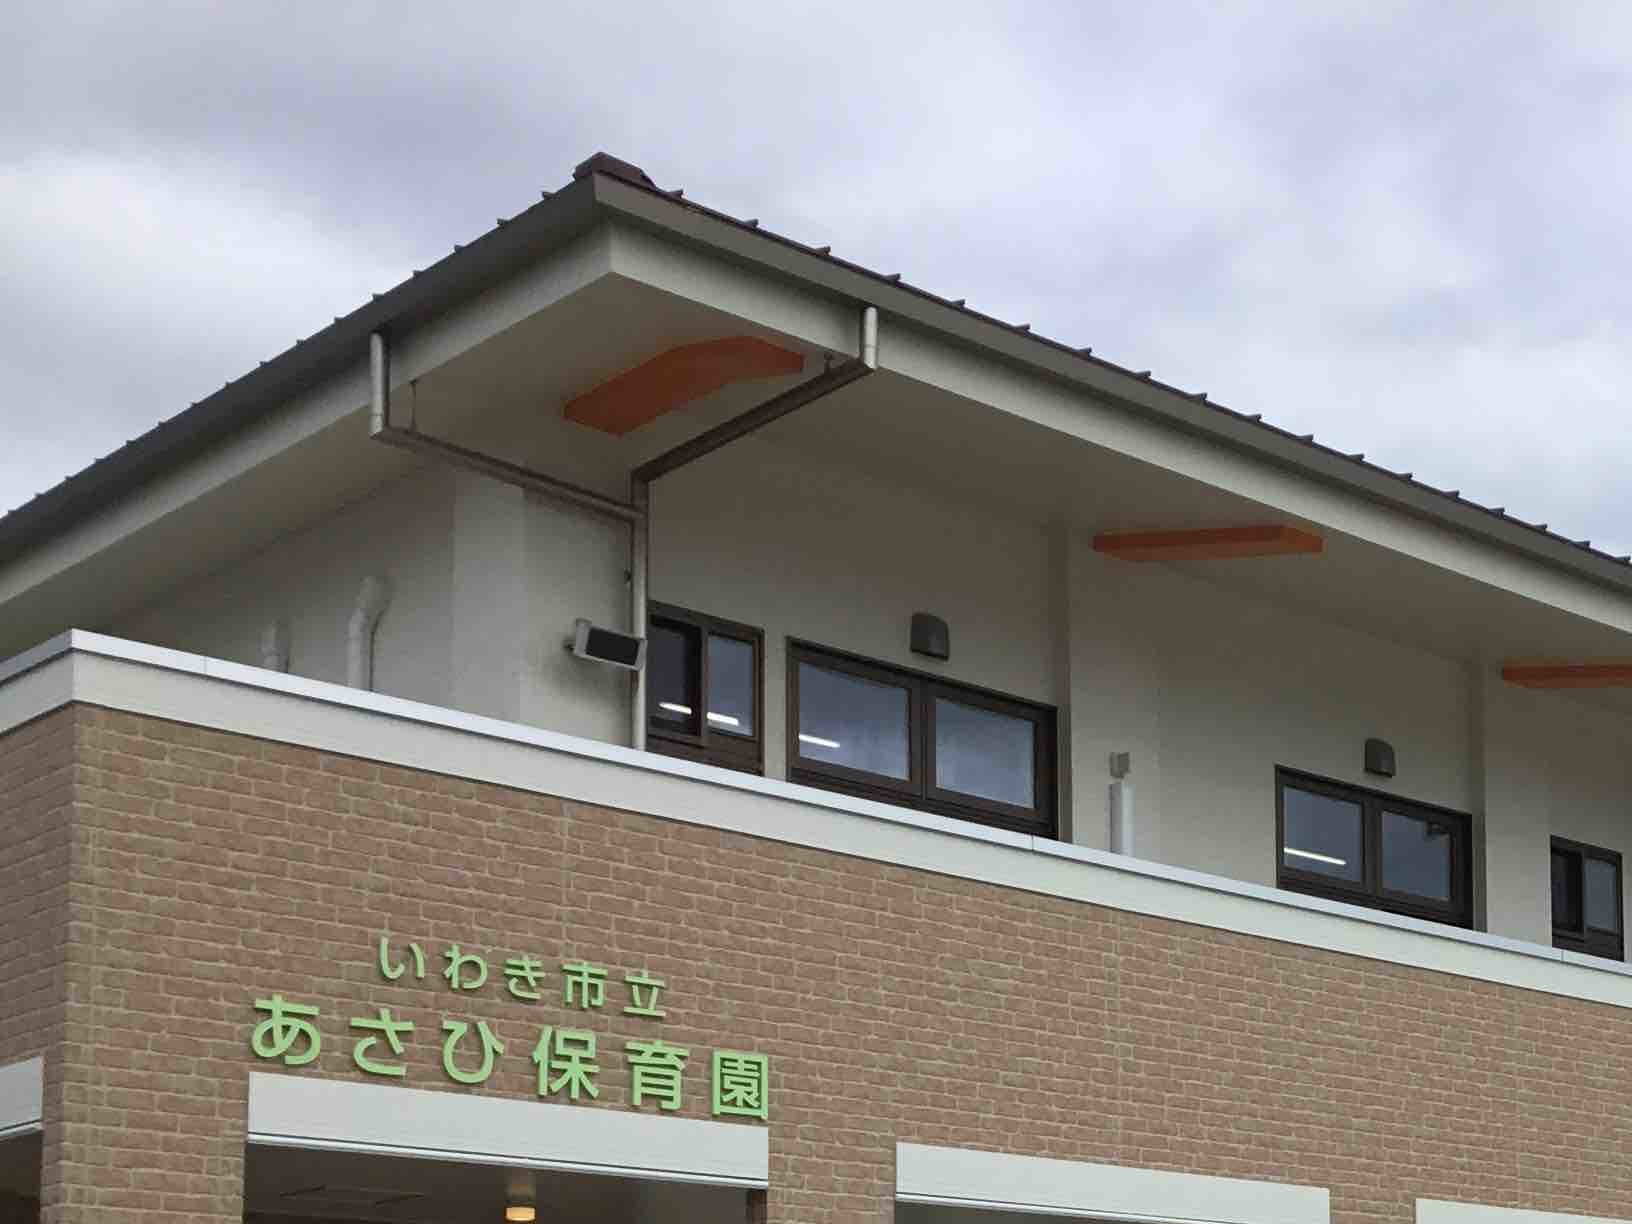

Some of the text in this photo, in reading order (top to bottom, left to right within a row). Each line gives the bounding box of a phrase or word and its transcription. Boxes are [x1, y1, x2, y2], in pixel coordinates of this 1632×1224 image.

[378, 934, 666, 1018] いわき市立
[251, 994, 770, 1120] あさひ保育園
